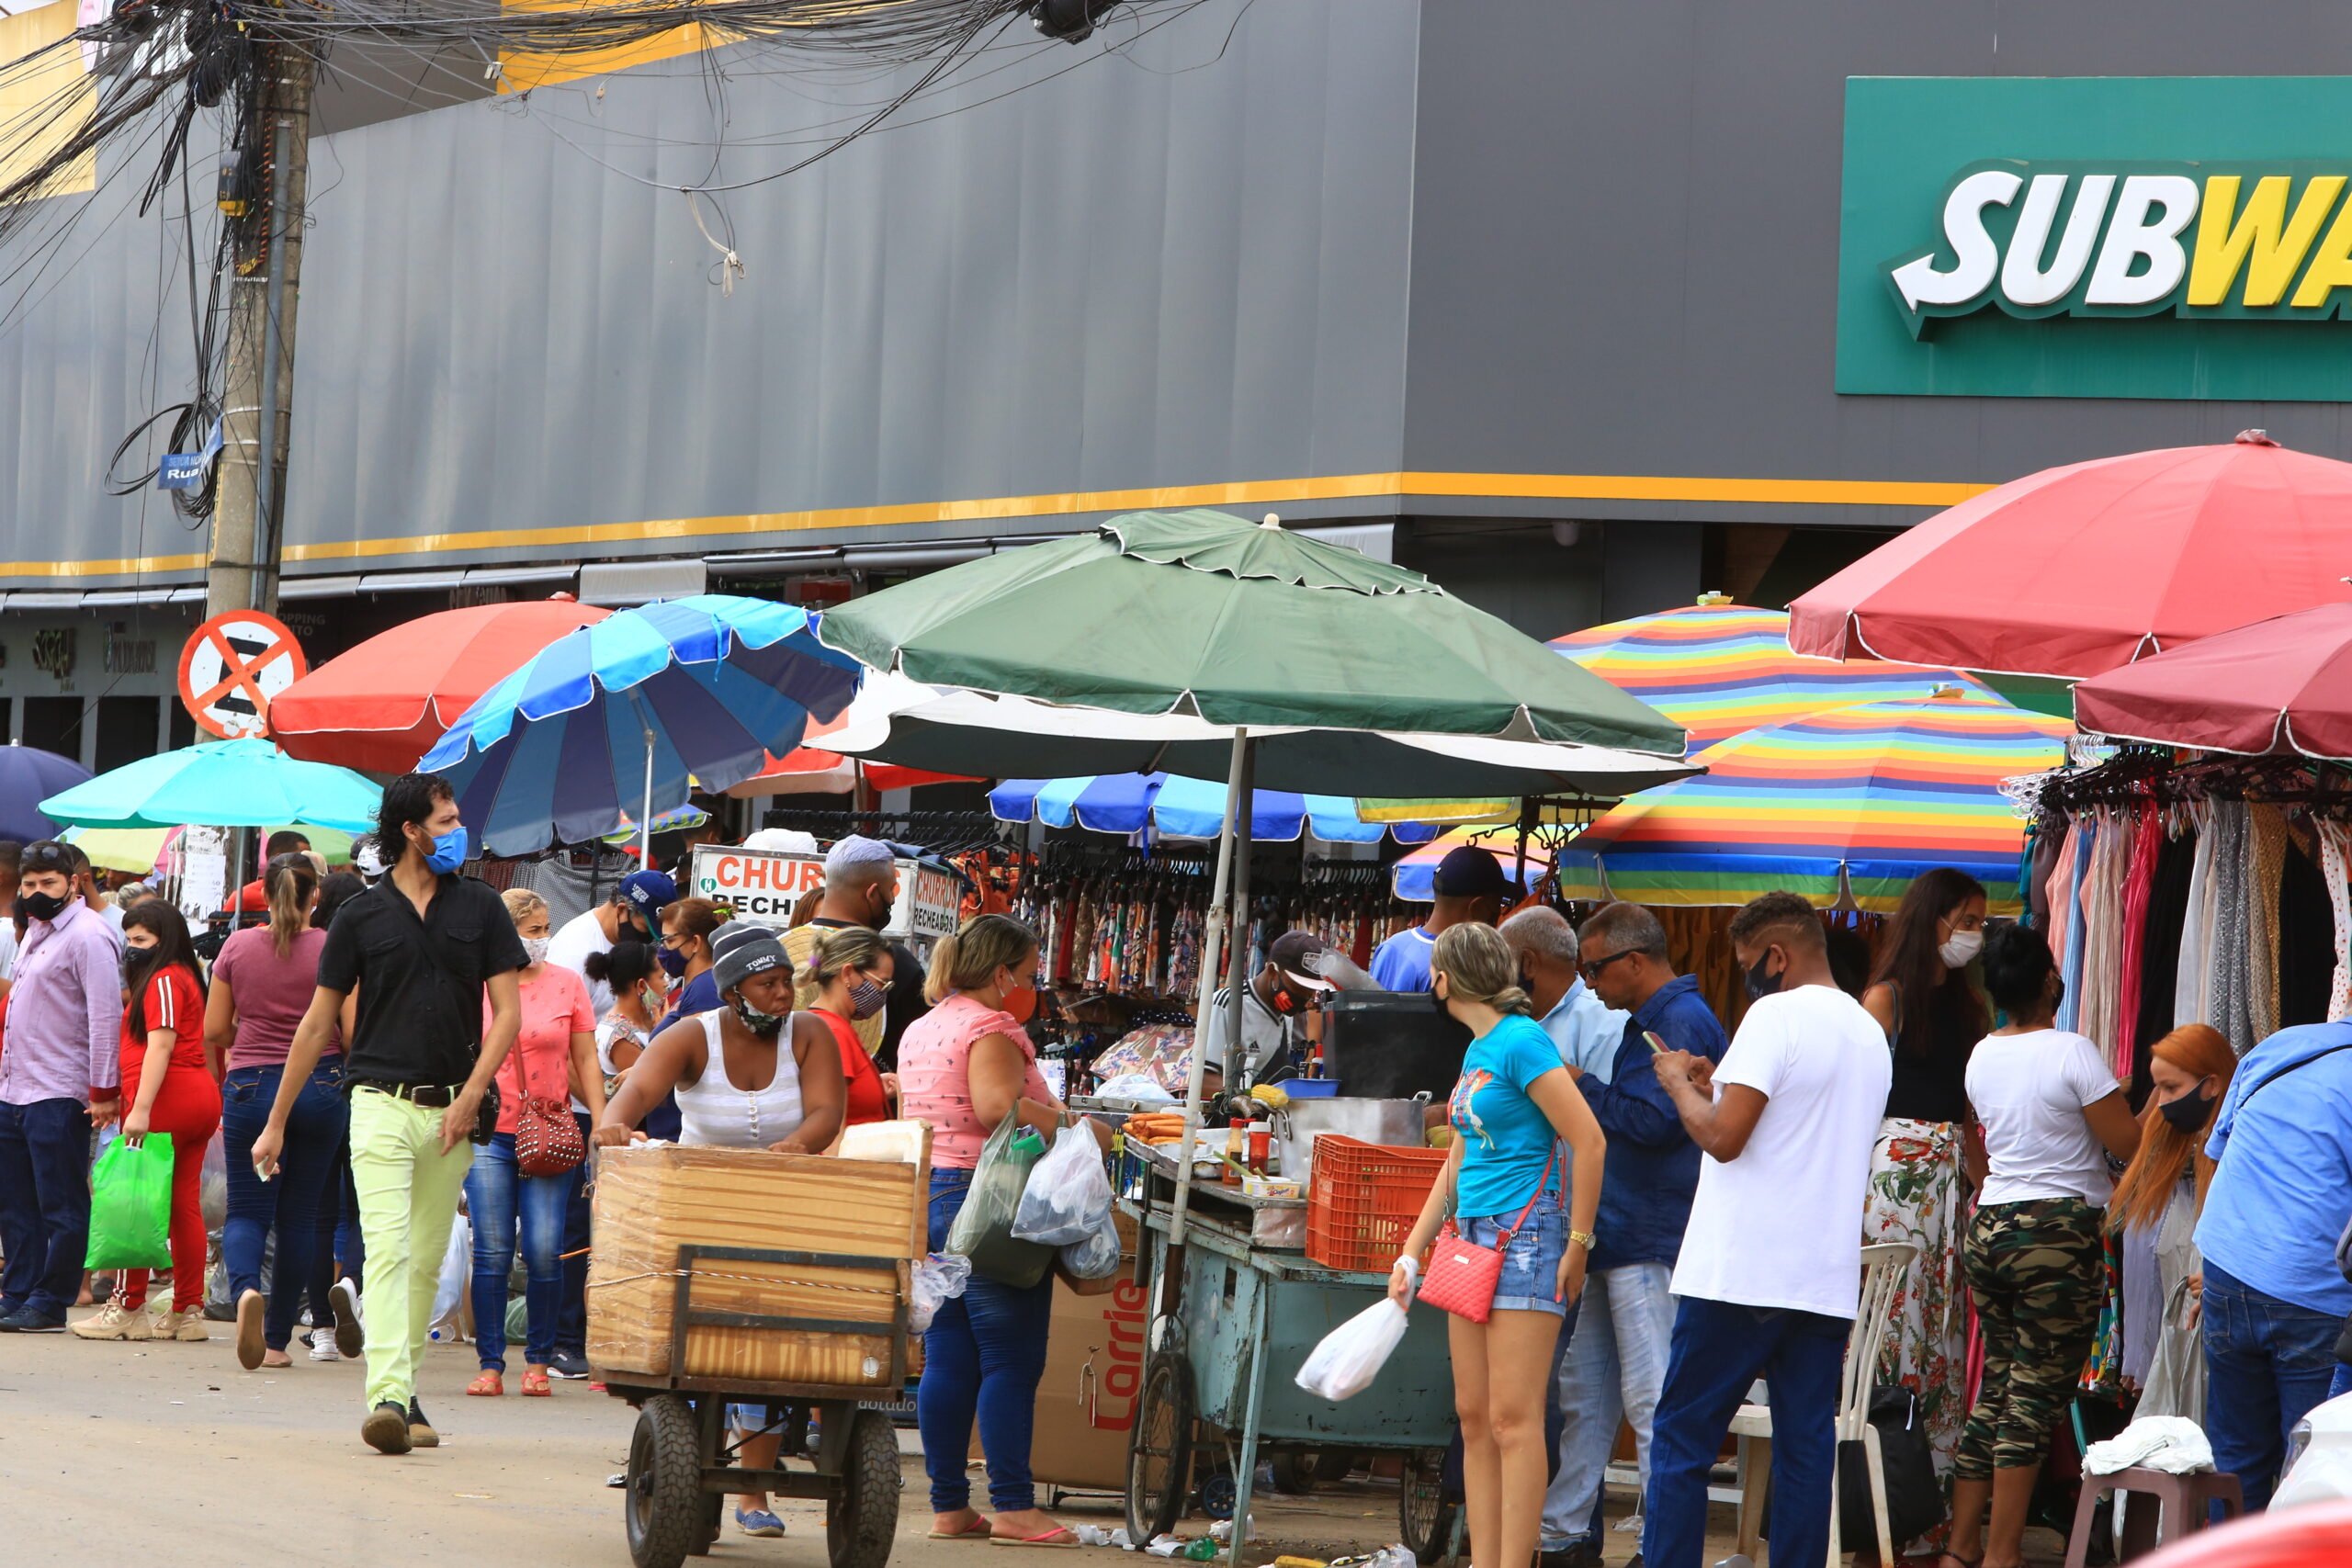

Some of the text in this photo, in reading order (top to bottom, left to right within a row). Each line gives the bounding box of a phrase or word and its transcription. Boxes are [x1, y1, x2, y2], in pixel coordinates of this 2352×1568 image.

[167, 468, 198, 479] Rua
[916, 872, 958, 909] CHURROS
[914, 908, 954, 933] RECHEADOS
[746, 954, 776, 971] TOMMY
